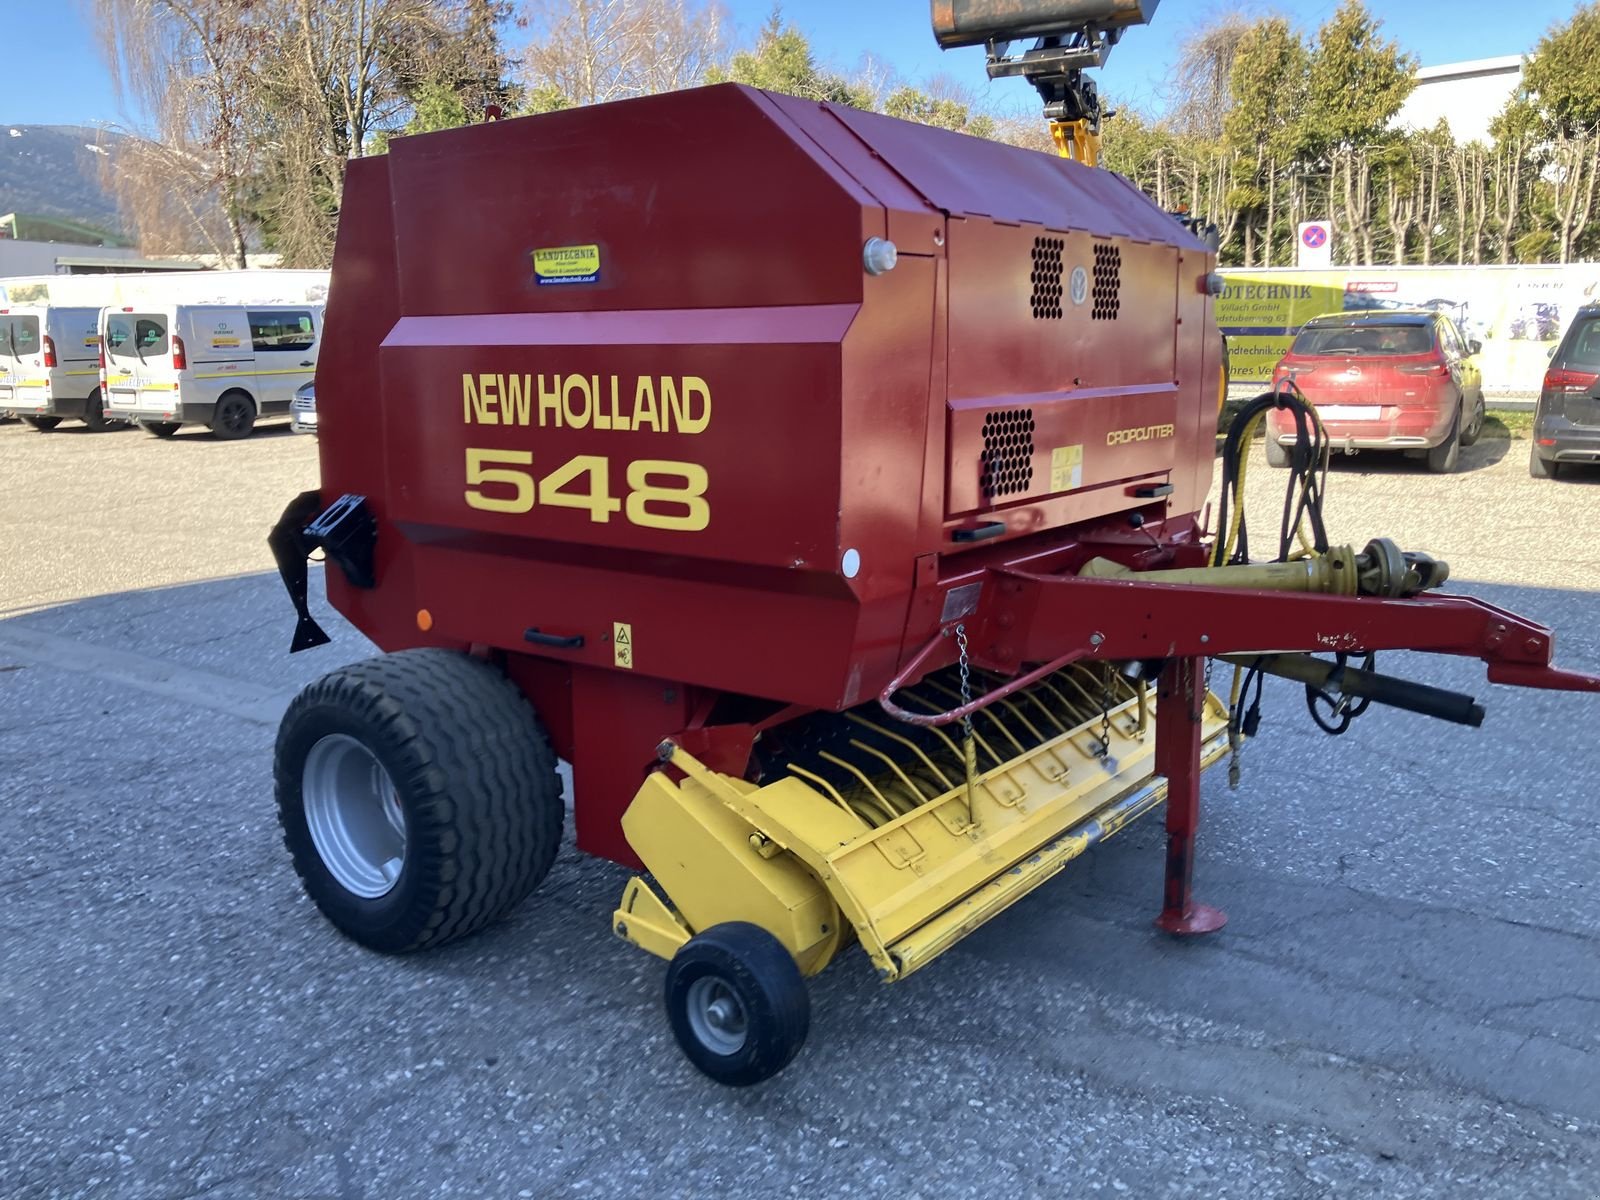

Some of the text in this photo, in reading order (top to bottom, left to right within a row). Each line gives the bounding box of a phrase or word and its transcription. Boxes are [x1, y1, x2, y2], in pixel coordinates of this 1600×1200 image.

[1216, 285, 1312, 299] DTECHNIK
[1221, 303, 1280, 311] Villach GmbH
[1228, 344, 1288, 355] ndtechnik.co
[1229, 365, 1254, 375] hres
[462, 374, 711, 434] NEW HOLLAND
[1107, 424, 1174, 445] CROPCUTTER
[465, 448, 711, 531] 548
